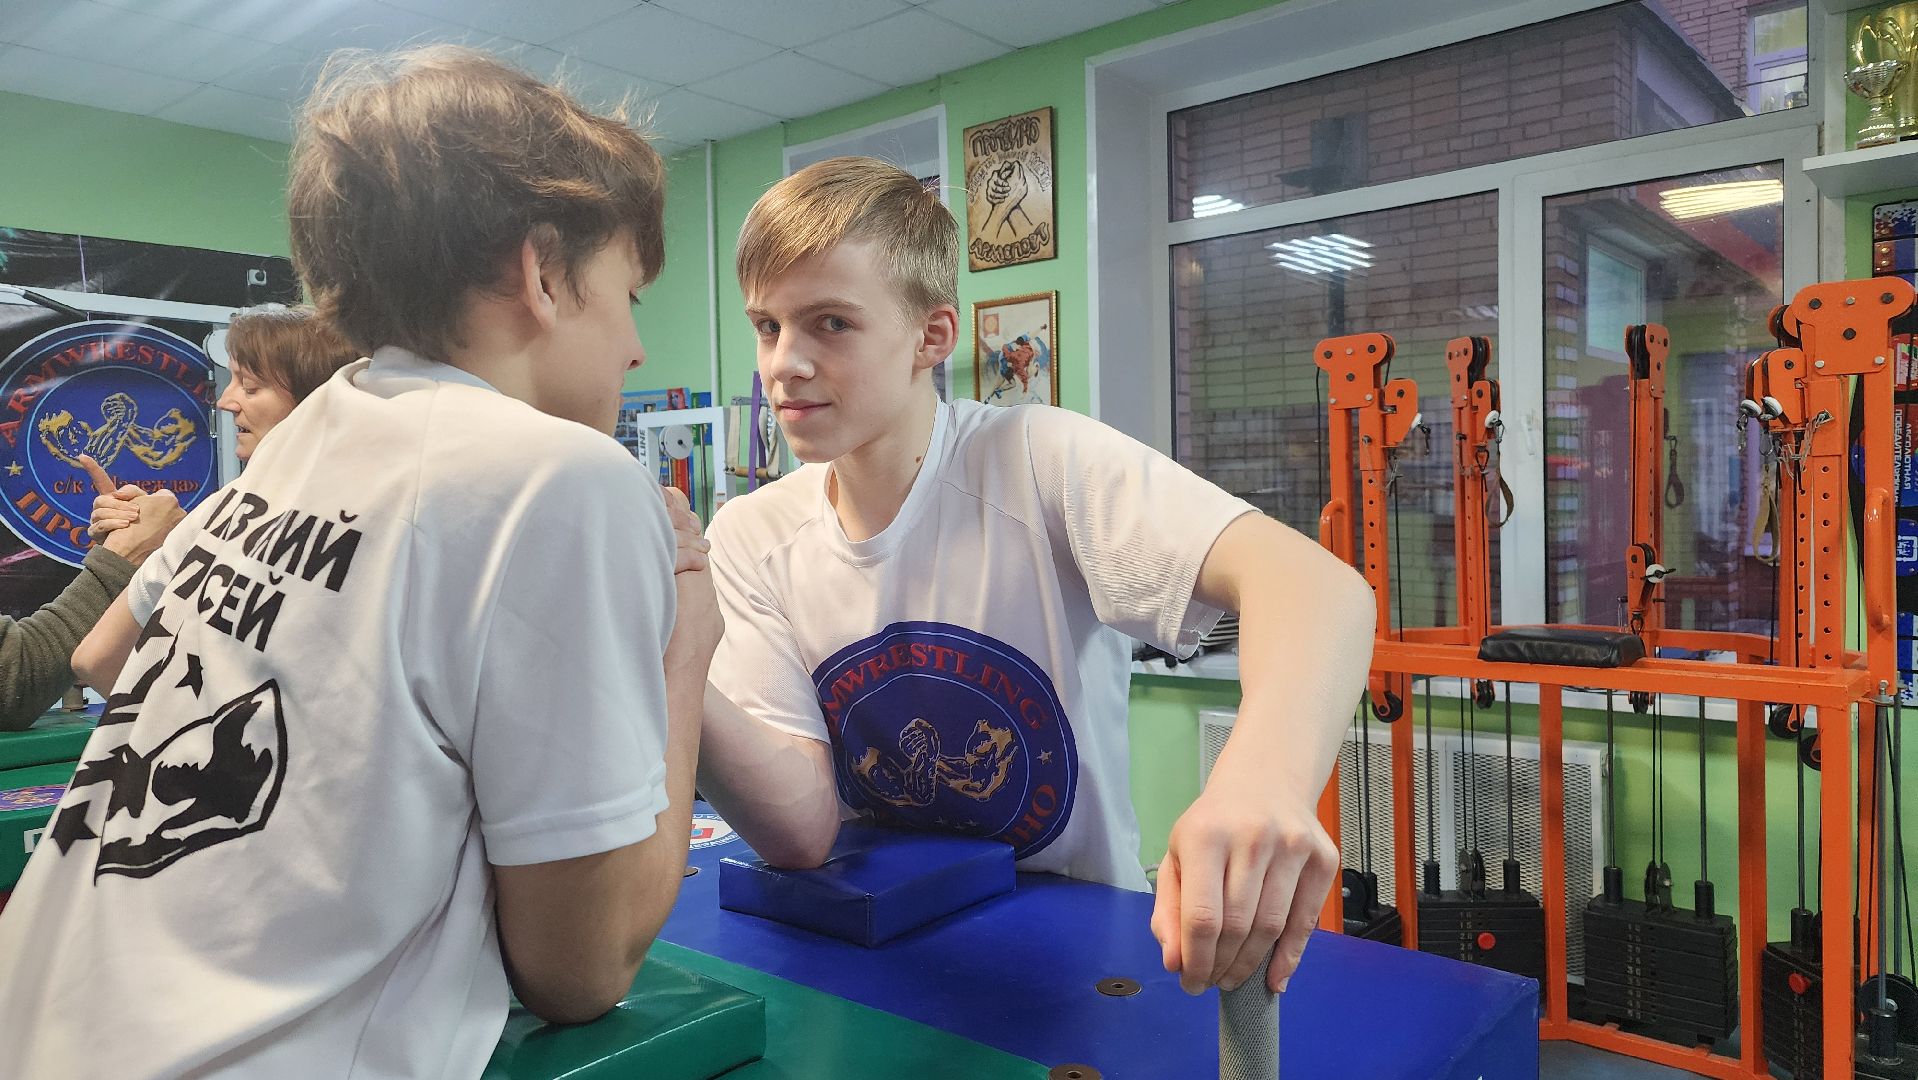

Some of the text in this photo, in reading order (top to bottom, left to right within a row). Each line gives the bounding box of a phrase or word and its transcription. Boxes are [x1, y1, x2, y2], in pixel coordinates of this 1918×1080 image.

[969, 117, 1041, 157] ПРОТВИНО
[969, 222, 1050, 263] АРМСПОРТ
[639, 429, 647, 457] LINE
[53, 475, 83, 495] с/к
[15, 490, 98, 549] ПРО
